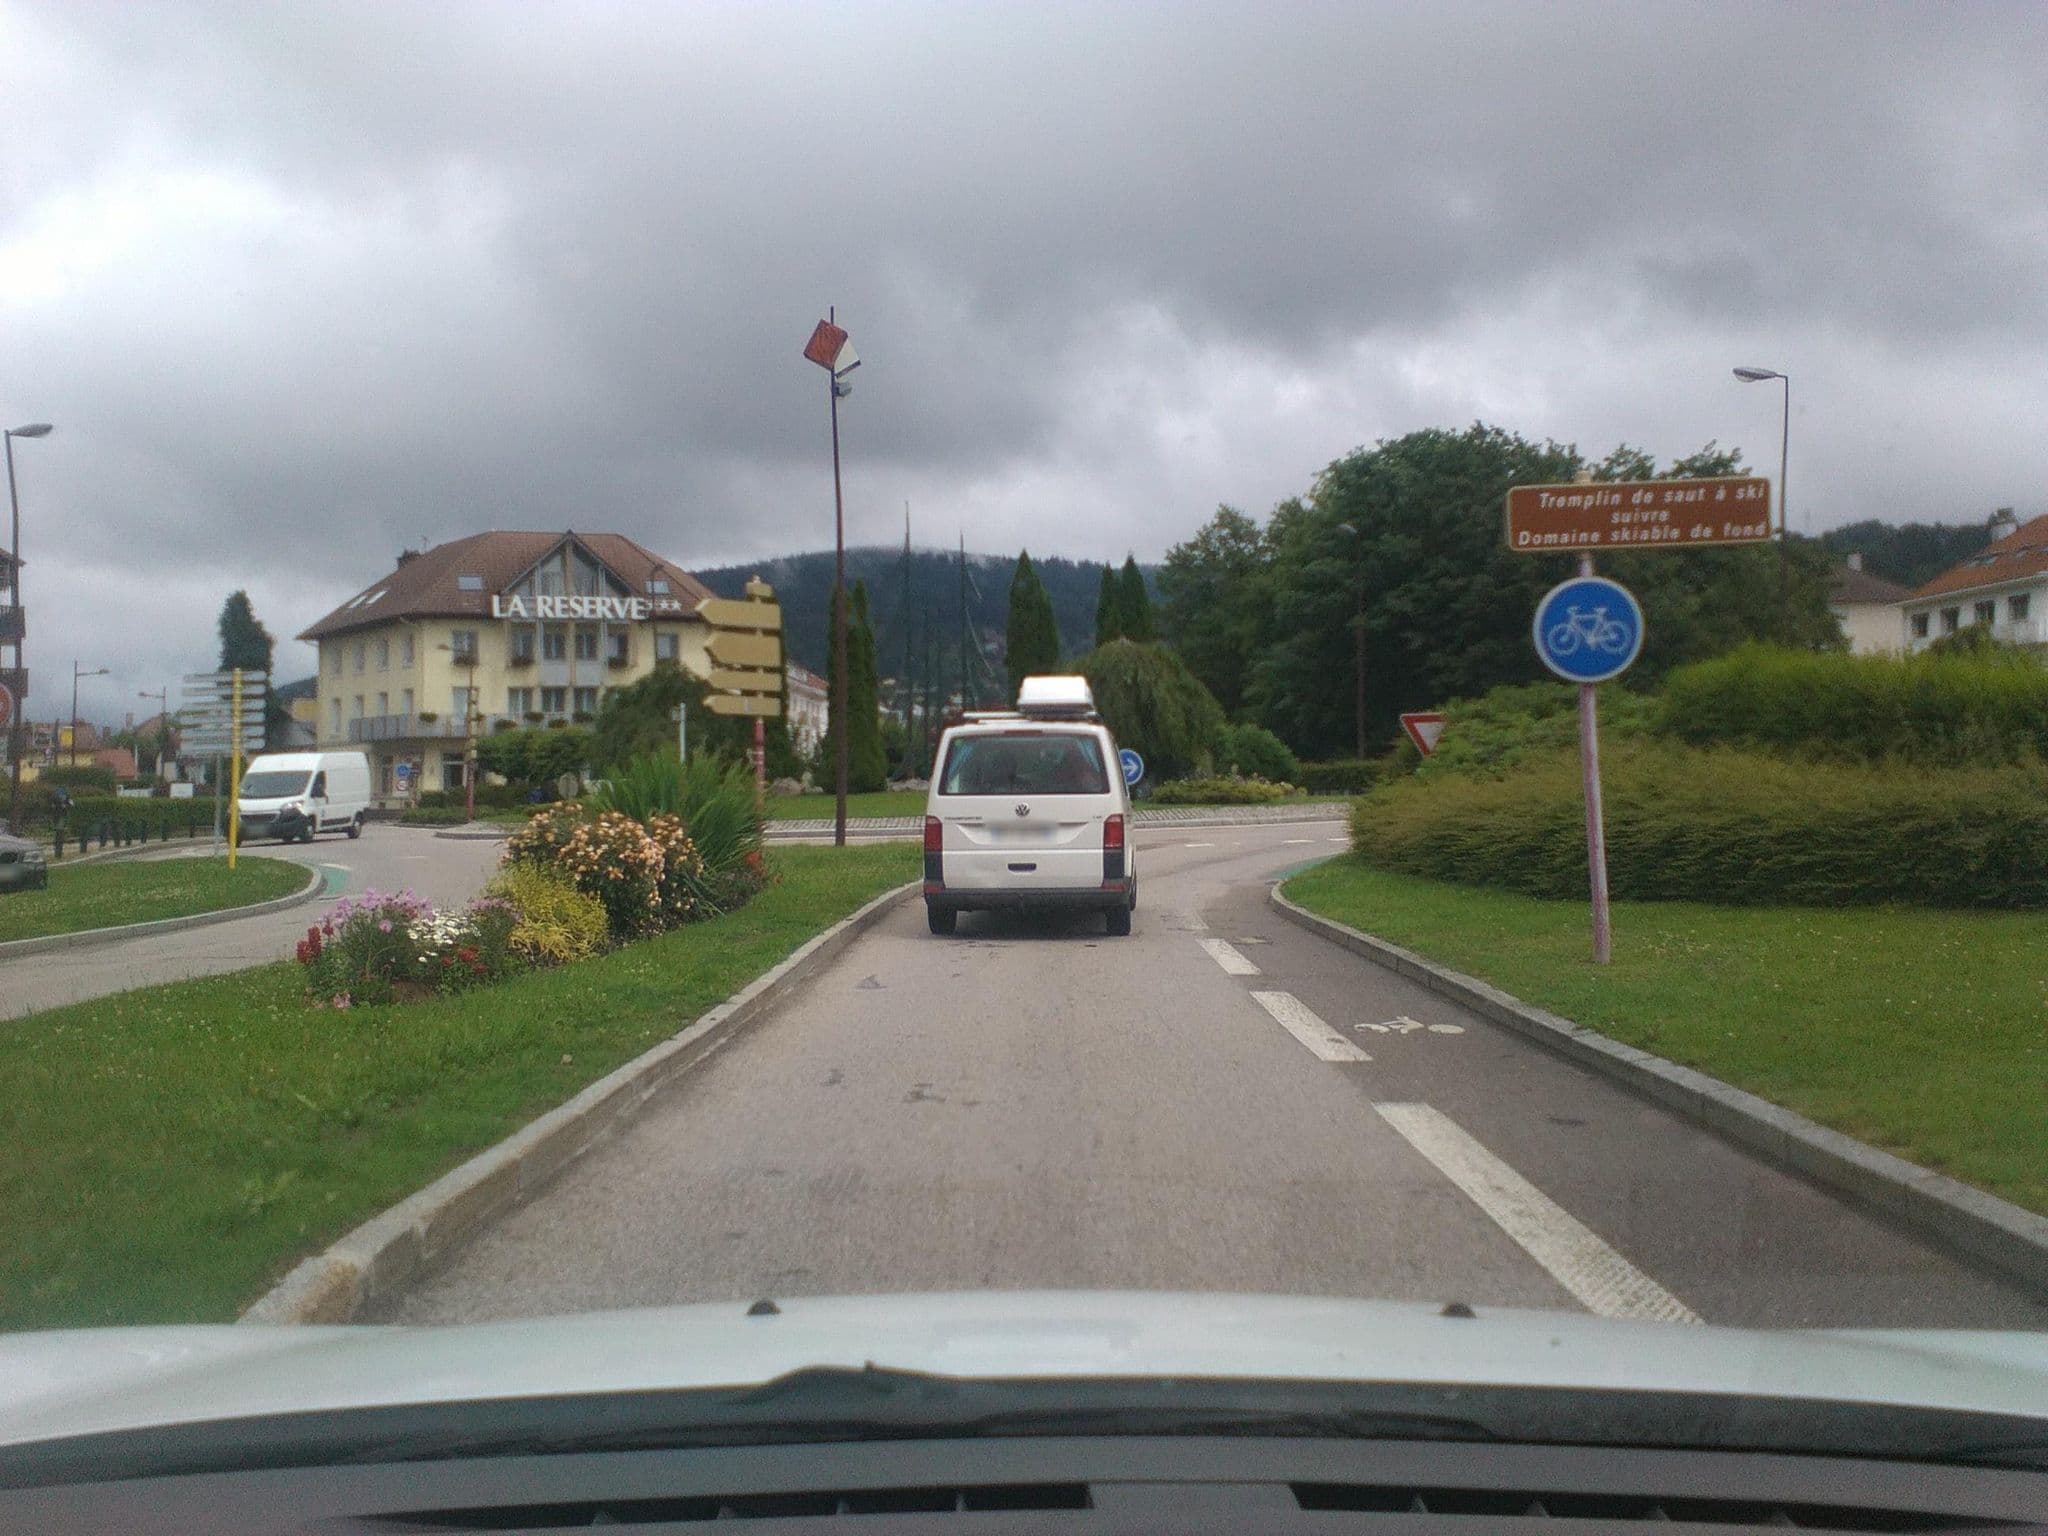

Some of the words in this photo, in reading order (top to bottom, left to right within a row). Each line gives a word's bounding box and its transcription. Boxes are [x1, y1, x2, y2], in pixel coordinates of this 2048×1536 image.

[1540, 490, 1621, 511] Tremplin
[1631, 487, 1654, 504] de
[1664, 487, 1706, 503] saut
[1736, 482, 1765, 500] ski
[1611, 507, 1670, 524] suivre
[1518, 528, 1600, 545] Domaine
[1611, 524, 1680, 542] skiable
[1690, 522, 1712, 539] de
[1723, 521, 1766, 538] fond
[492, 594, 528, 618] LA
[537, 594, 647, 620] RESERVE
